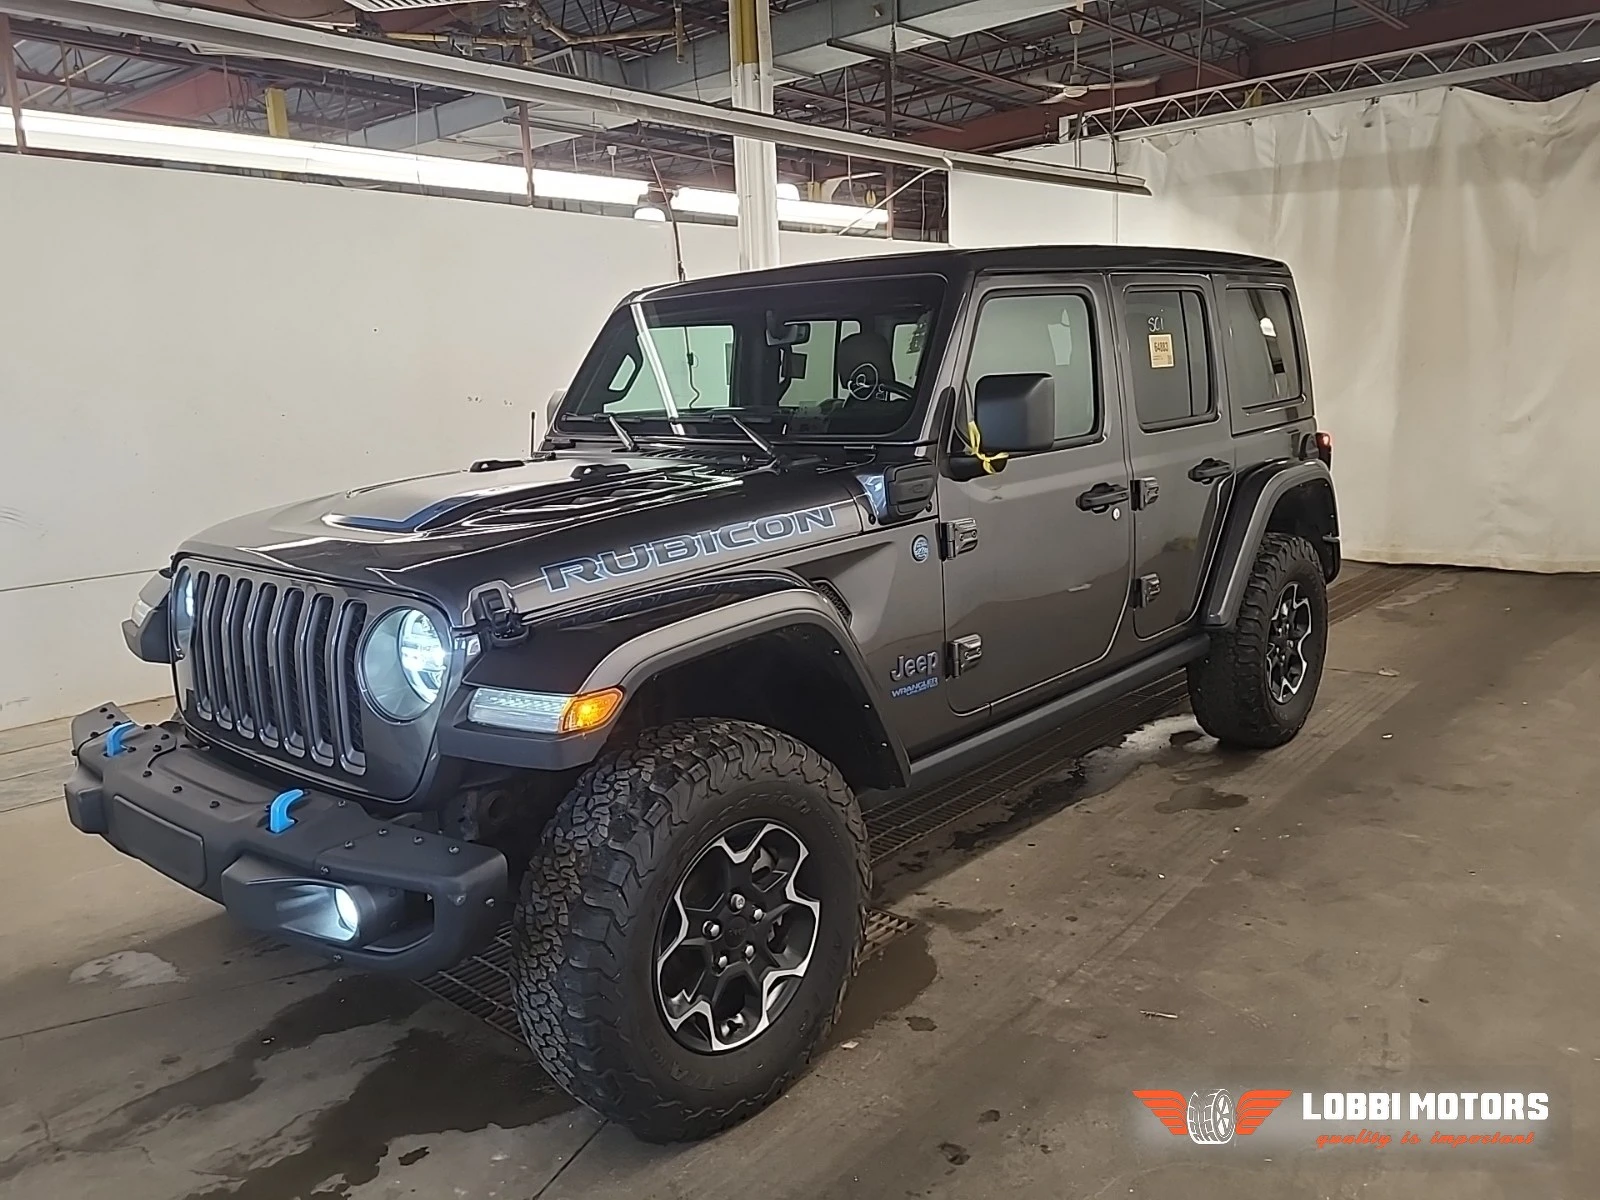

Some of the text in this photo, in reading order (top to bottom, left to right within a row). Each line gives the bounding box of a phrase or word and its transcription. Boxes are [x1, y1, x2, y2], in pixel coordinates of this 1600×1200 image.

[540, 505, 836, 592] RUBICON
[891, 651, 939, 681] Jeep
[891, 677, 938, 697] WRANGLER
